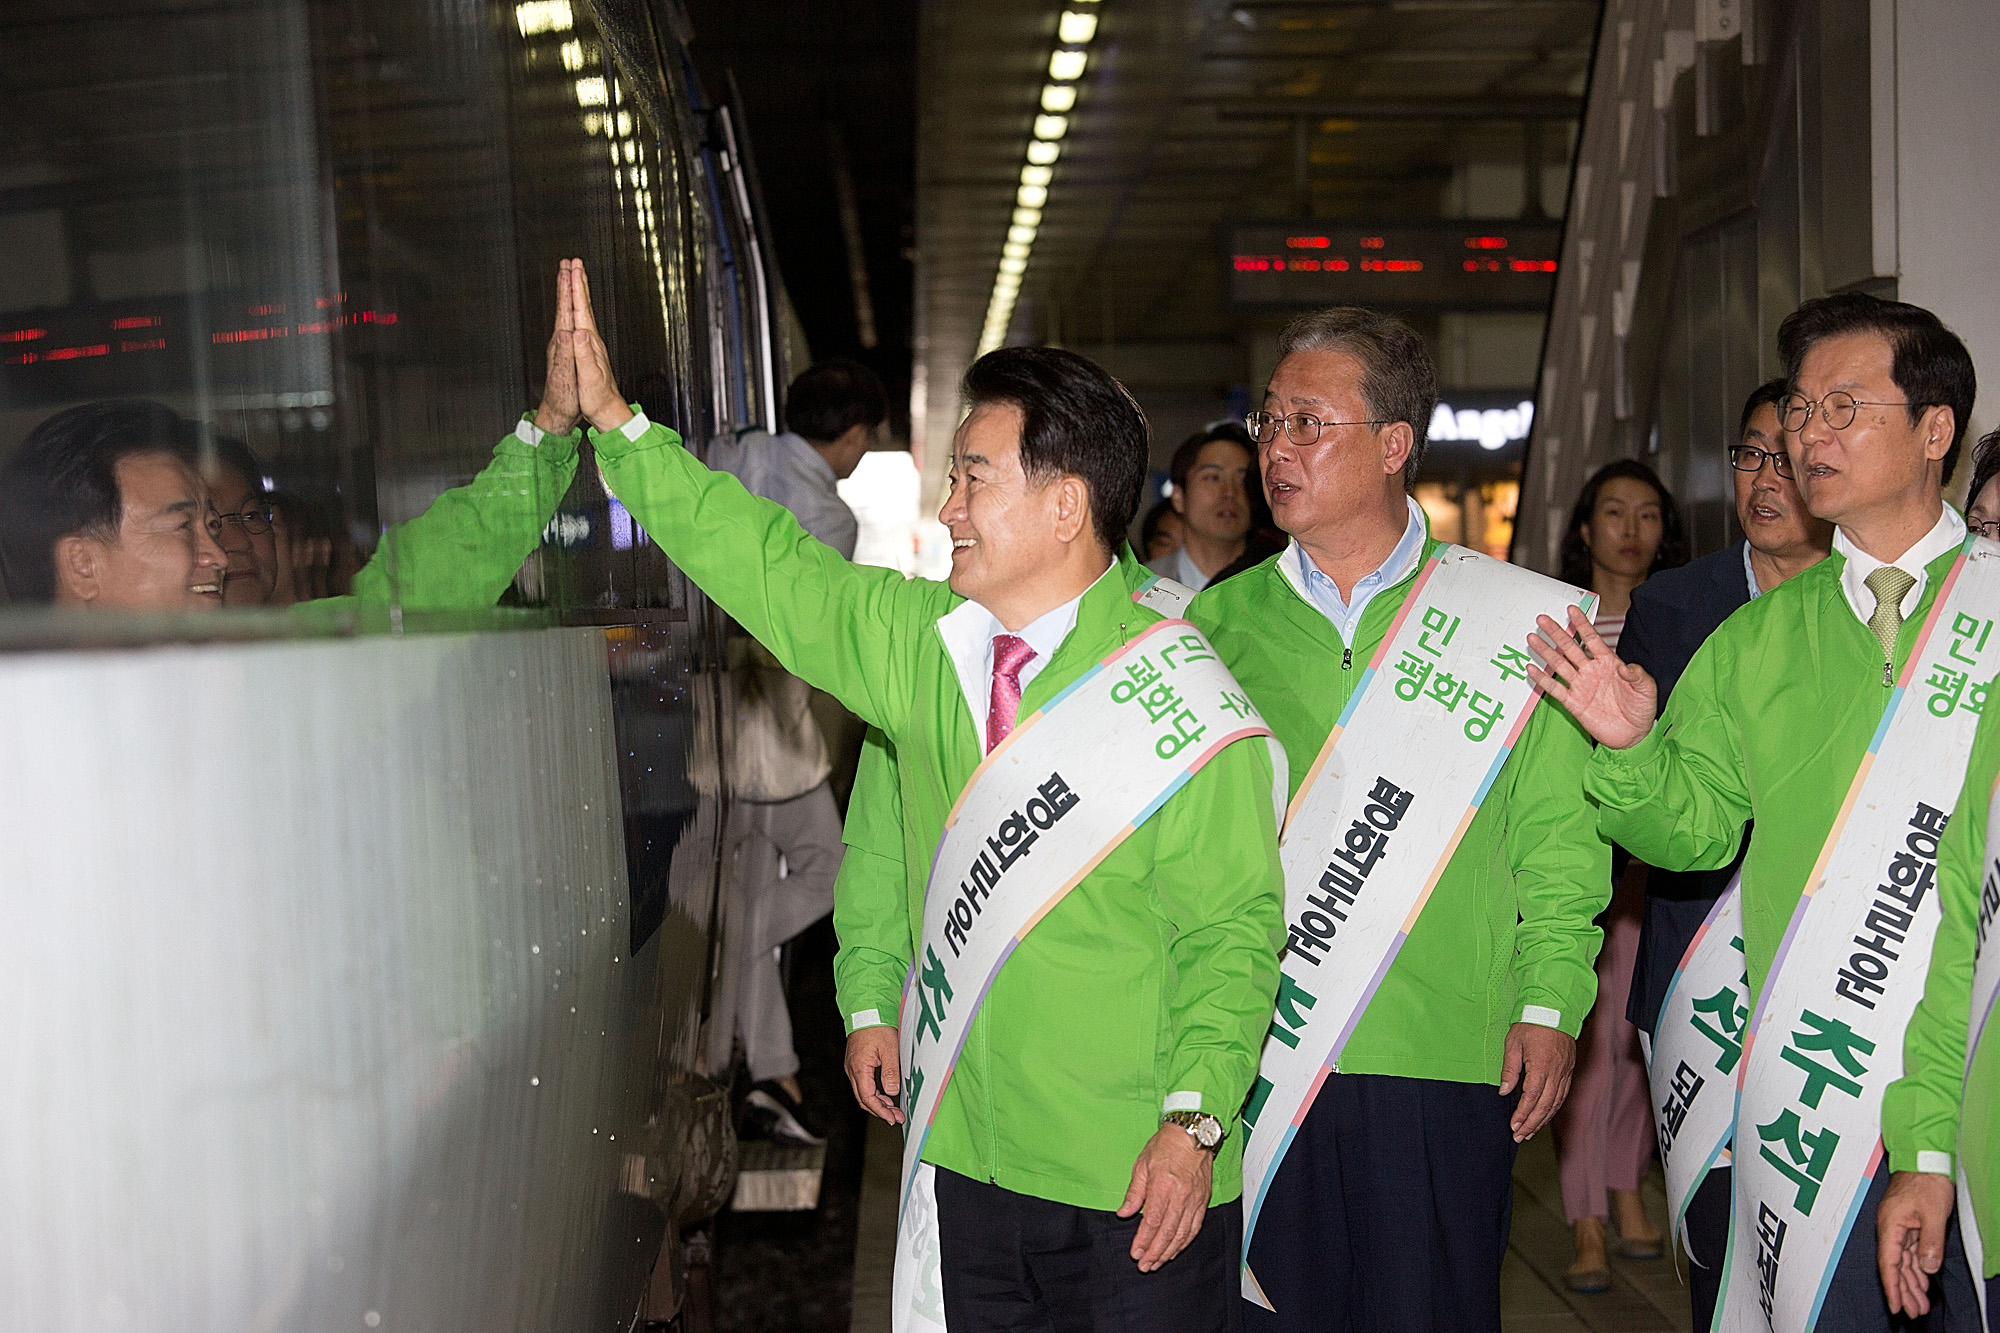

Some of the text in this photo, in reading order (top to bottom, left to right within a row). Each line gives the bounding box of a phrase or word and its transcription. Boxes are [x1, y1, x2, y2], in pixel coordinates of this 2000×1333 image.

[1110, 655, 1207, 760] 평화당
[1394, 650, 1505, 742] 평화당
[1925, 663, 1991, 718] 평화
[943, 771, 1081, 958] 평화로운
[1286, 775, 1415, 967] 평화로운
[1835, 801, 1951, 1010] 평화로운
[1755, 1008, 1876, 1218] 추석
